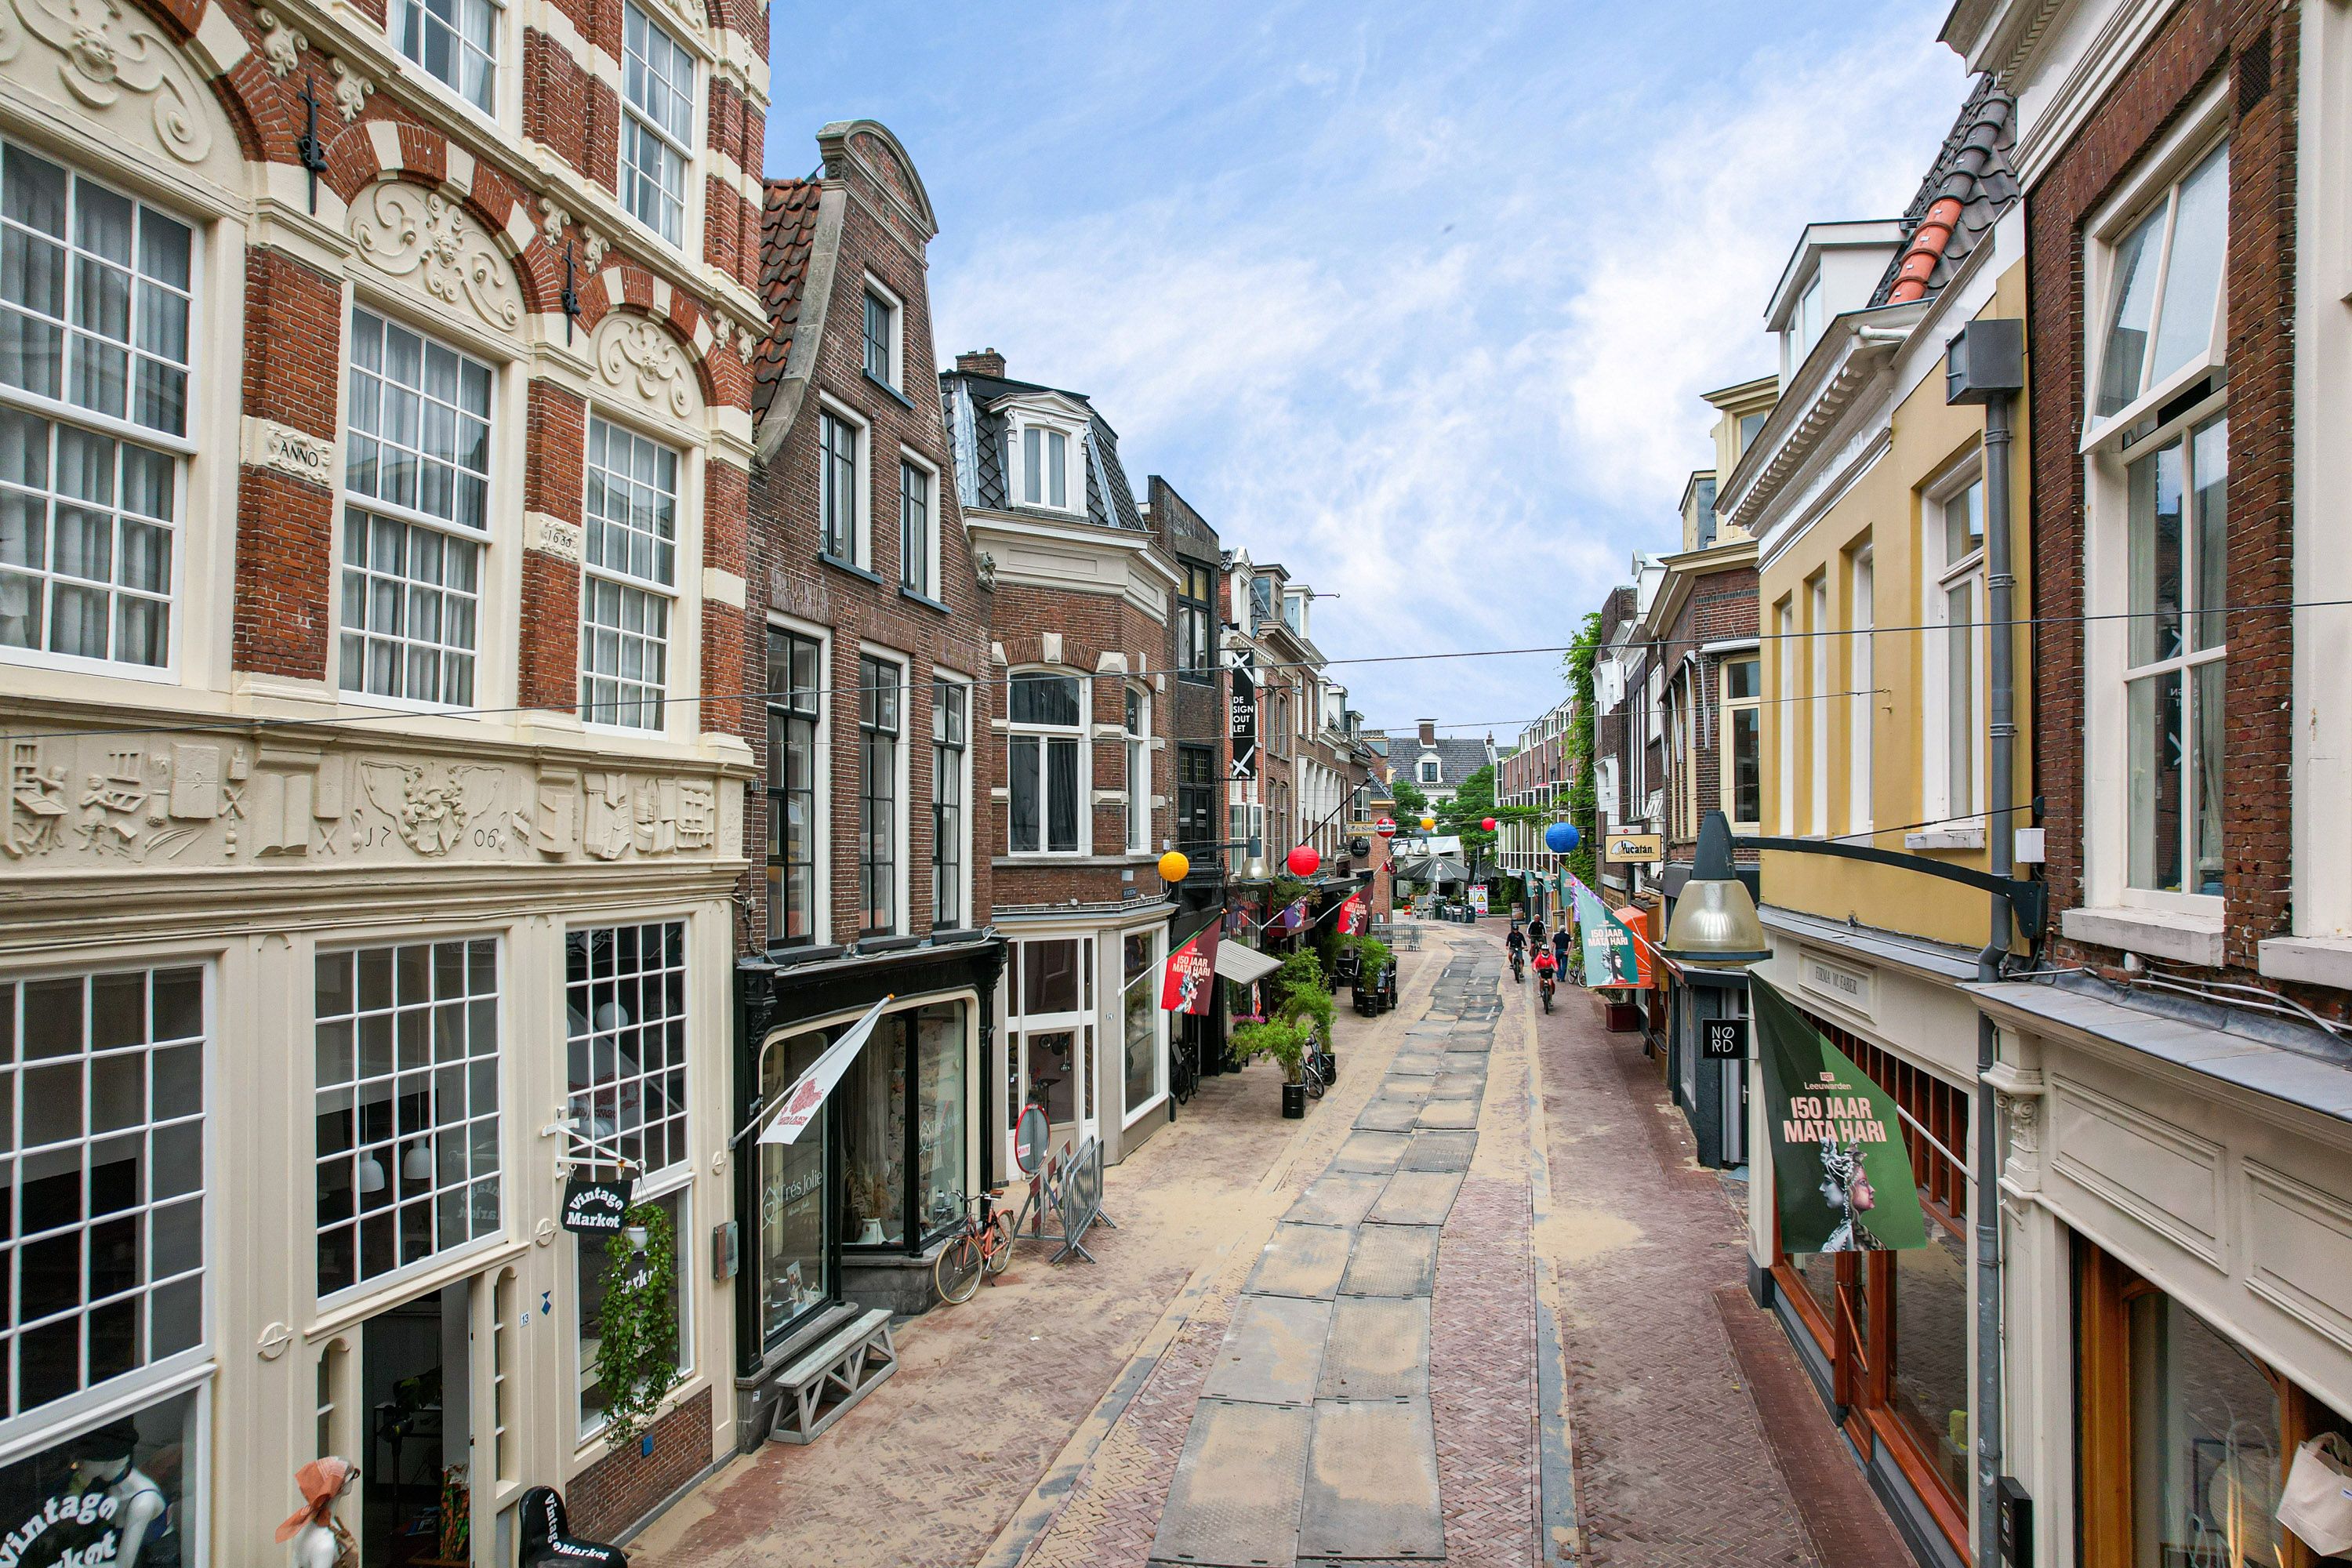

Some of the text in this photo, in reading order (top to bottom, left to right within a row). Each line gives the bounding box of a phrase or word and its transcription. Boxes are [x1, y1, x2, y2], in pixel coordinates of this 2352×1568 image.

[280, 440, 318, 467] ANNO
[1588, 937, 1628, 946] MATA HARI
[1605, 928, 1624, 938] JAAR
[1172, 963, 1210, 977] MATA HARI
[1189, 956, 1208, 967] JAAR
[1840, 975, 1857, 994] FABER
[1711, 1039, 1733, 1052] RD
[1804, 1082, 1852, 1091] Leeuwarden
[1790, 1097, 1873, 1119] 150 JAAR
[1783, 1120, 1887, 1142] MATA HARI
[802, 1169, 822, 1196] Jolie
[569, 1186, 623, 1210] Vintage
[565, 1211, 620, 1229] Market
[522, 1313, 529, 1324] 13
[0, 1493, 118, 1568] Vintage
[545, 1493, 562, 1551] Vintage
[560, 1544, 609, 1561] Market
